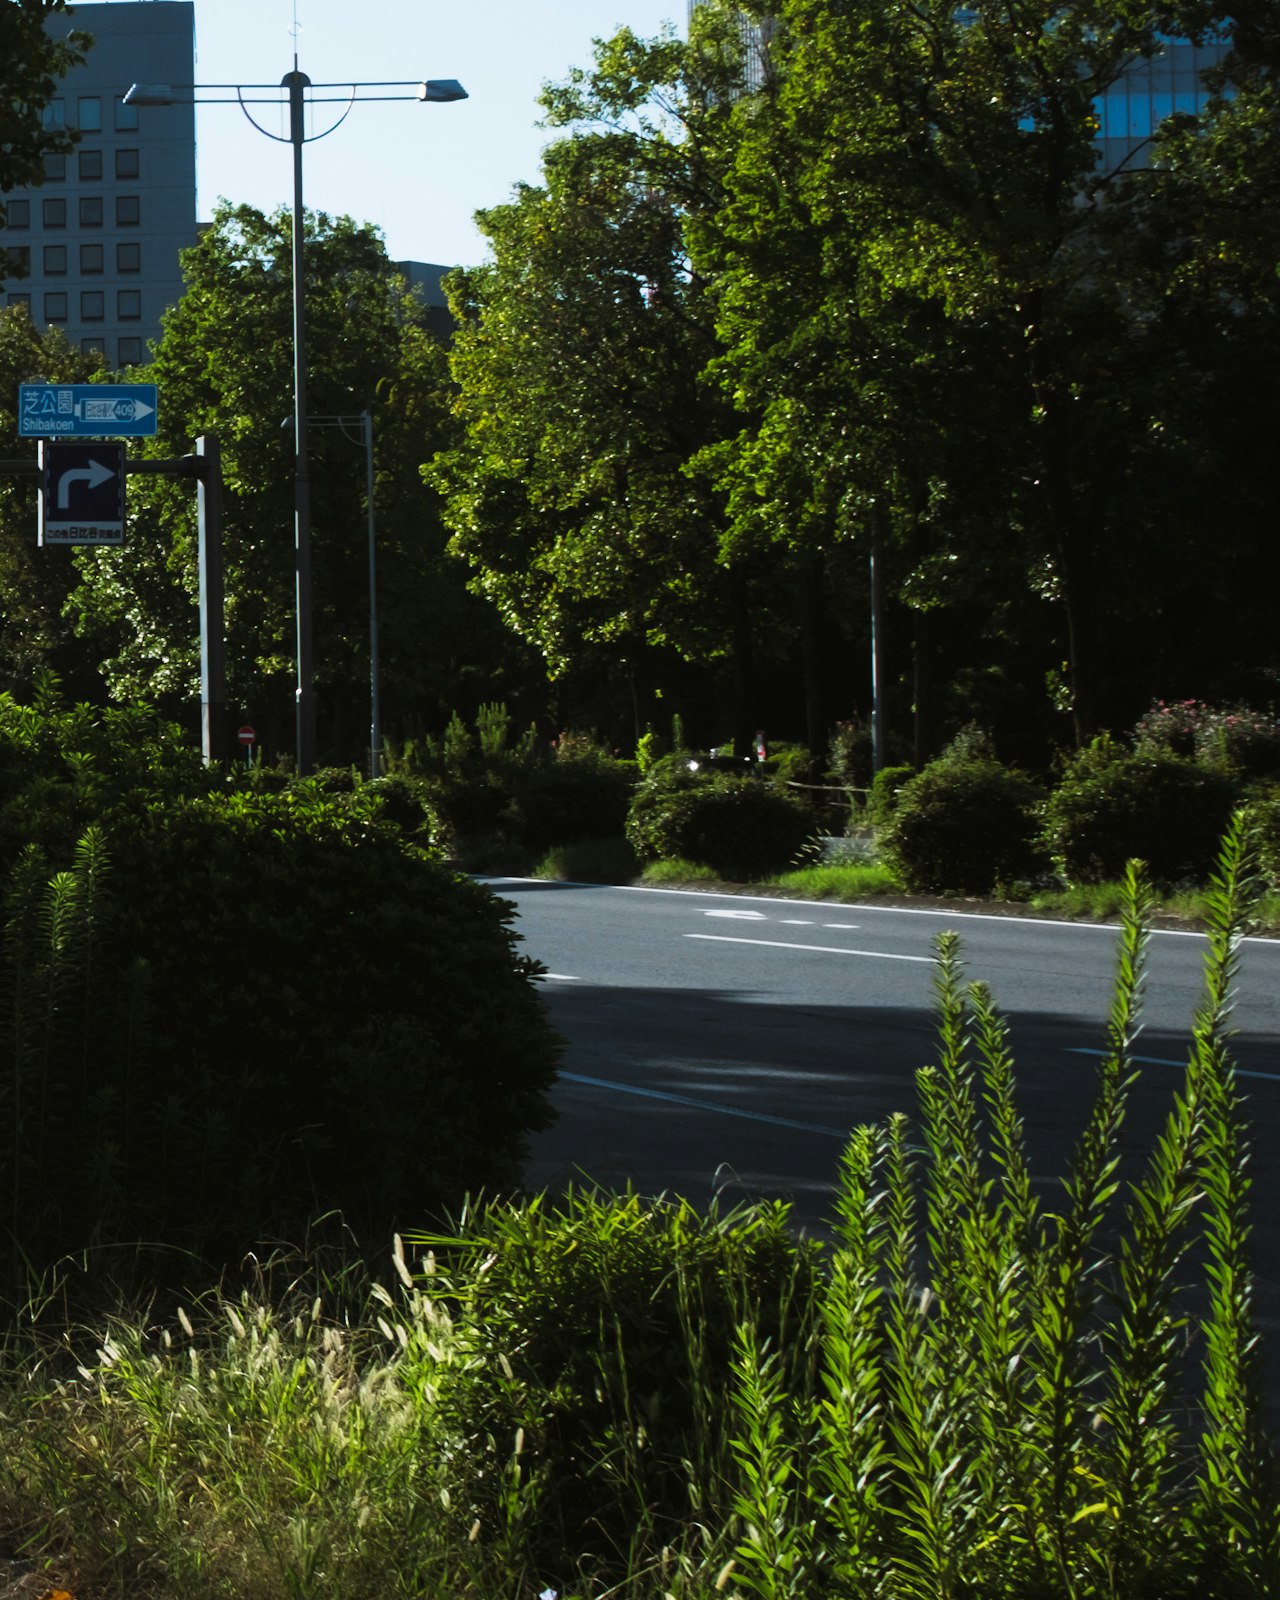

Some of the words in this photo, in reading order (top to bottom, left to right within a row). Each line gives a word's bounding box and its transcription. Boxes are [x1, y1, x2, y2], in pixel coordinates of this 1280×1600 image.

[23, 390, 74, 415] 芝公園
[114, 404, 134, 417] 409
[22, 417, 74, 431] Shibakoen
